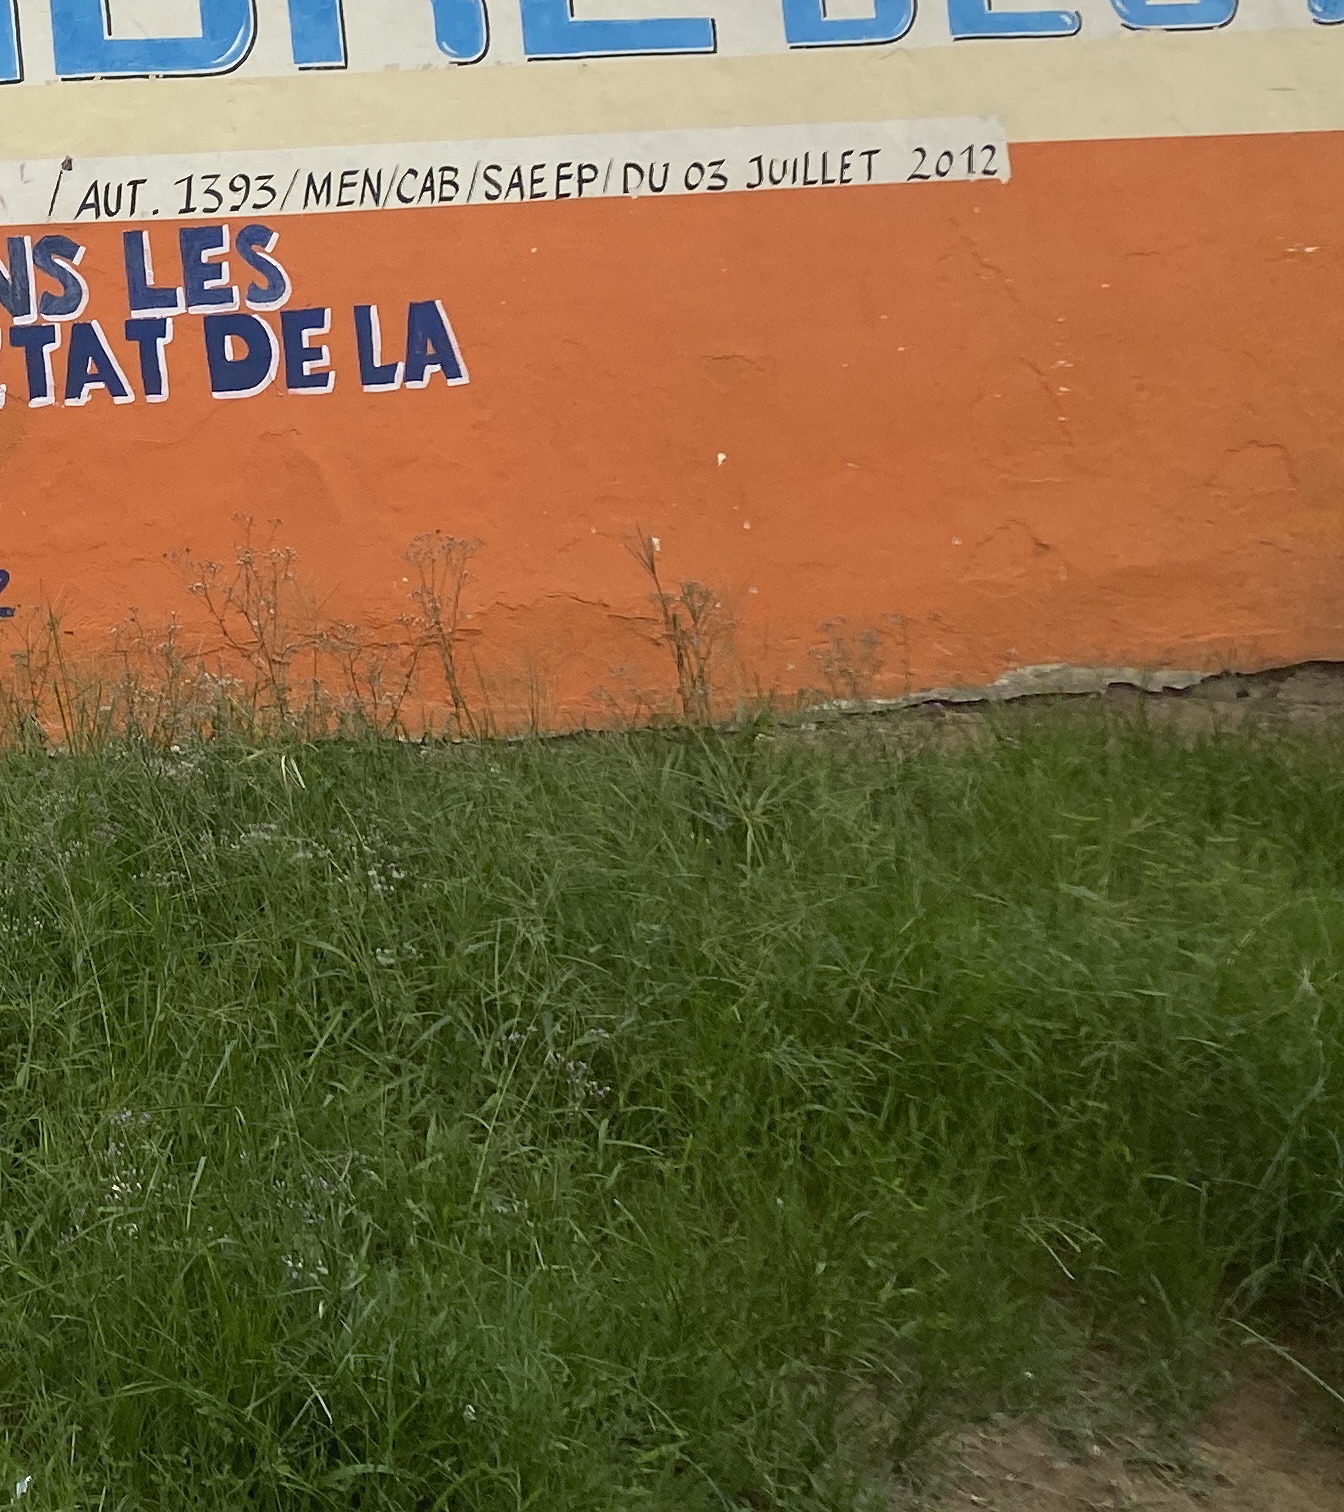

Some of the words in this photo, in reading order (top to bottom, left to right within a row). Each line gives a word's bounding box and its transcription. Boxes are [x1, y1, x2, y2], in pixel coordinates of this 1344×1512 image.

[684, 159, 729, 191] 03
[746, 149, 881, 189] JUILLET
[908, 144, 998, 182] 2012
[123, 224, 292, 318] LES
[203, 308, 331, 399] DE
[354, 300, 469, 393] LA
